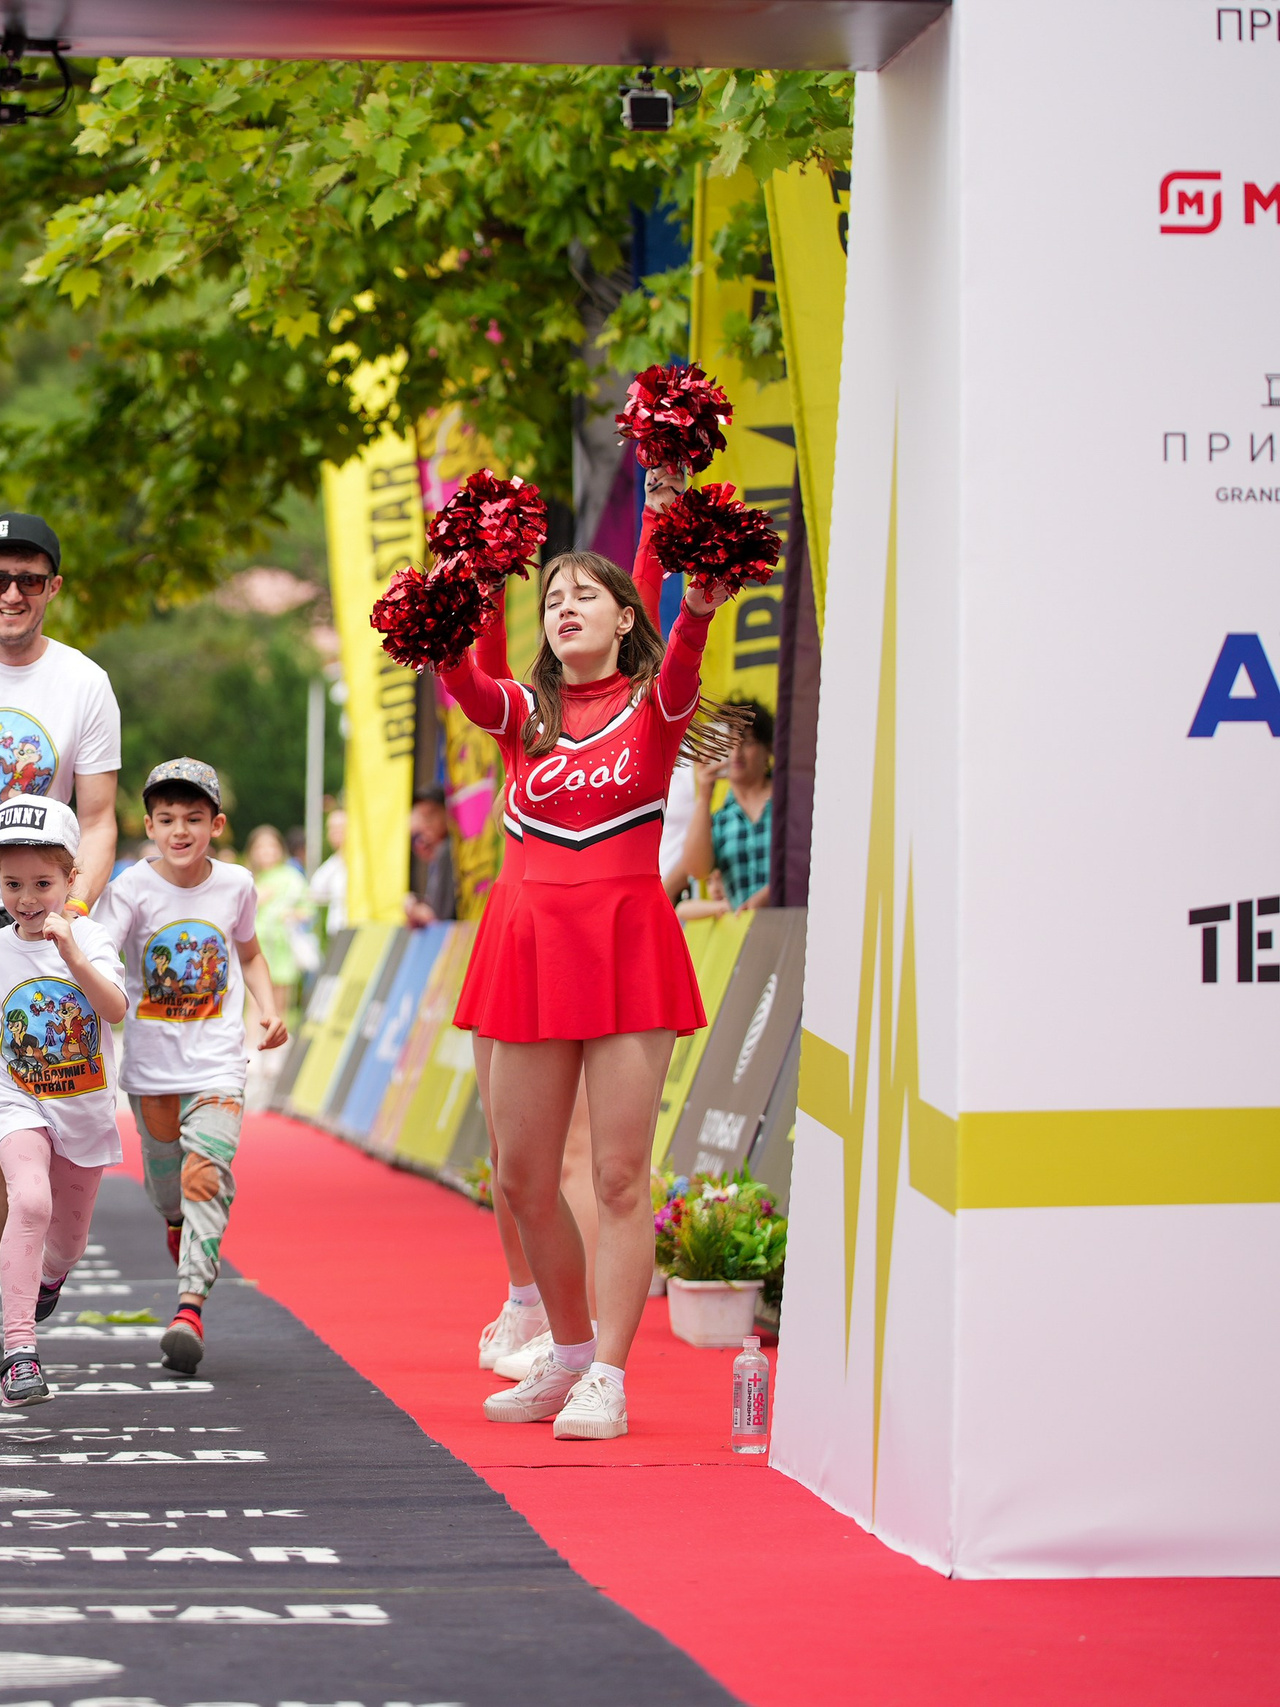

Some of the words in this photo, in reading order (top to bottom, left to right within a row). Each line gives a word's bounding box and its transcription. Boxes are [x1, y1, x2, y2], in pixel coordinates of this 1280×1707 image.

[1217, 8, 1280, 41] ПР
[1163, 432, 1274, 462] ПРИ
[525, 747, 632, 802] Cool
[33, 1080, 76, 1094] ОТВАГА
